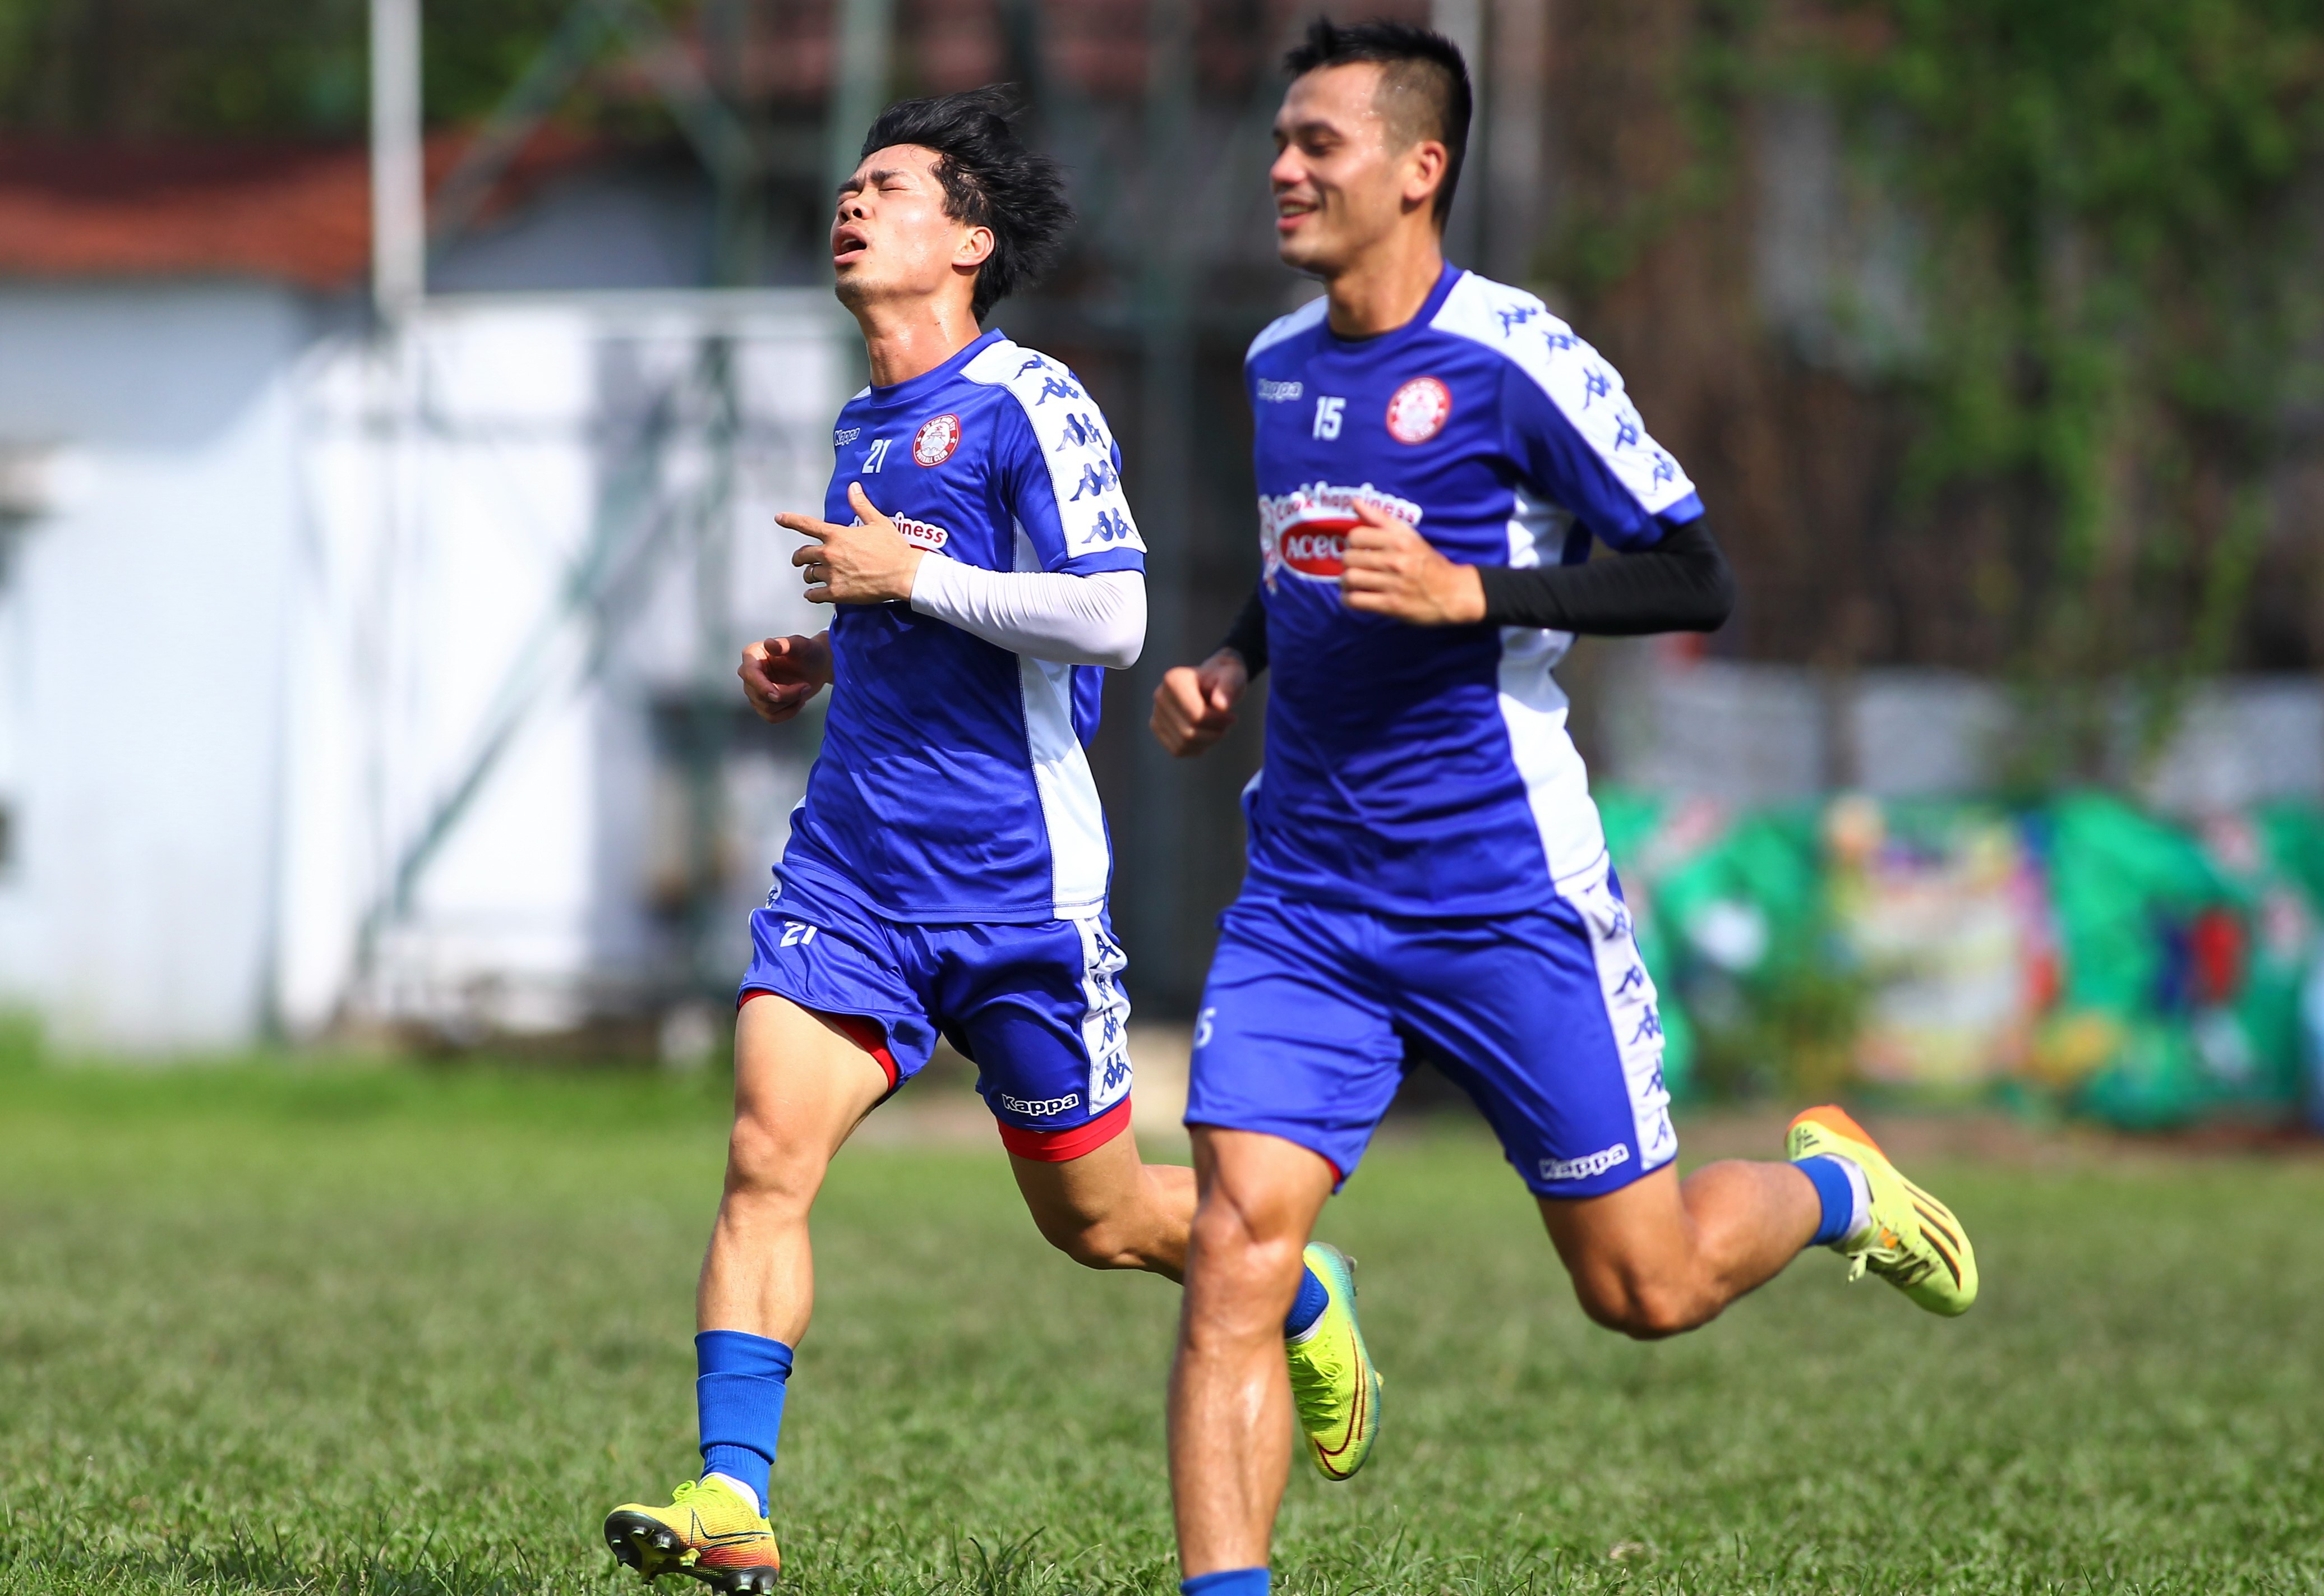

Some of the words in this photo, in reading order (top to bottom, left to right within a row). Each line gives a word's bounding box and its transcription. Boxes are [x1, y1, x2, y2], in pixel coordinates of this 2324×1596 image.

[1312, 396, 1346, 441] 15
[834, 428, 860, 446] Kappa
[862, 439, 892, 473] 21
[780, 921, 818, 948] 21
[1002, 1094, 1079, 1116] Kappa
[1538, 1142, 1630, 1180] Kappa
